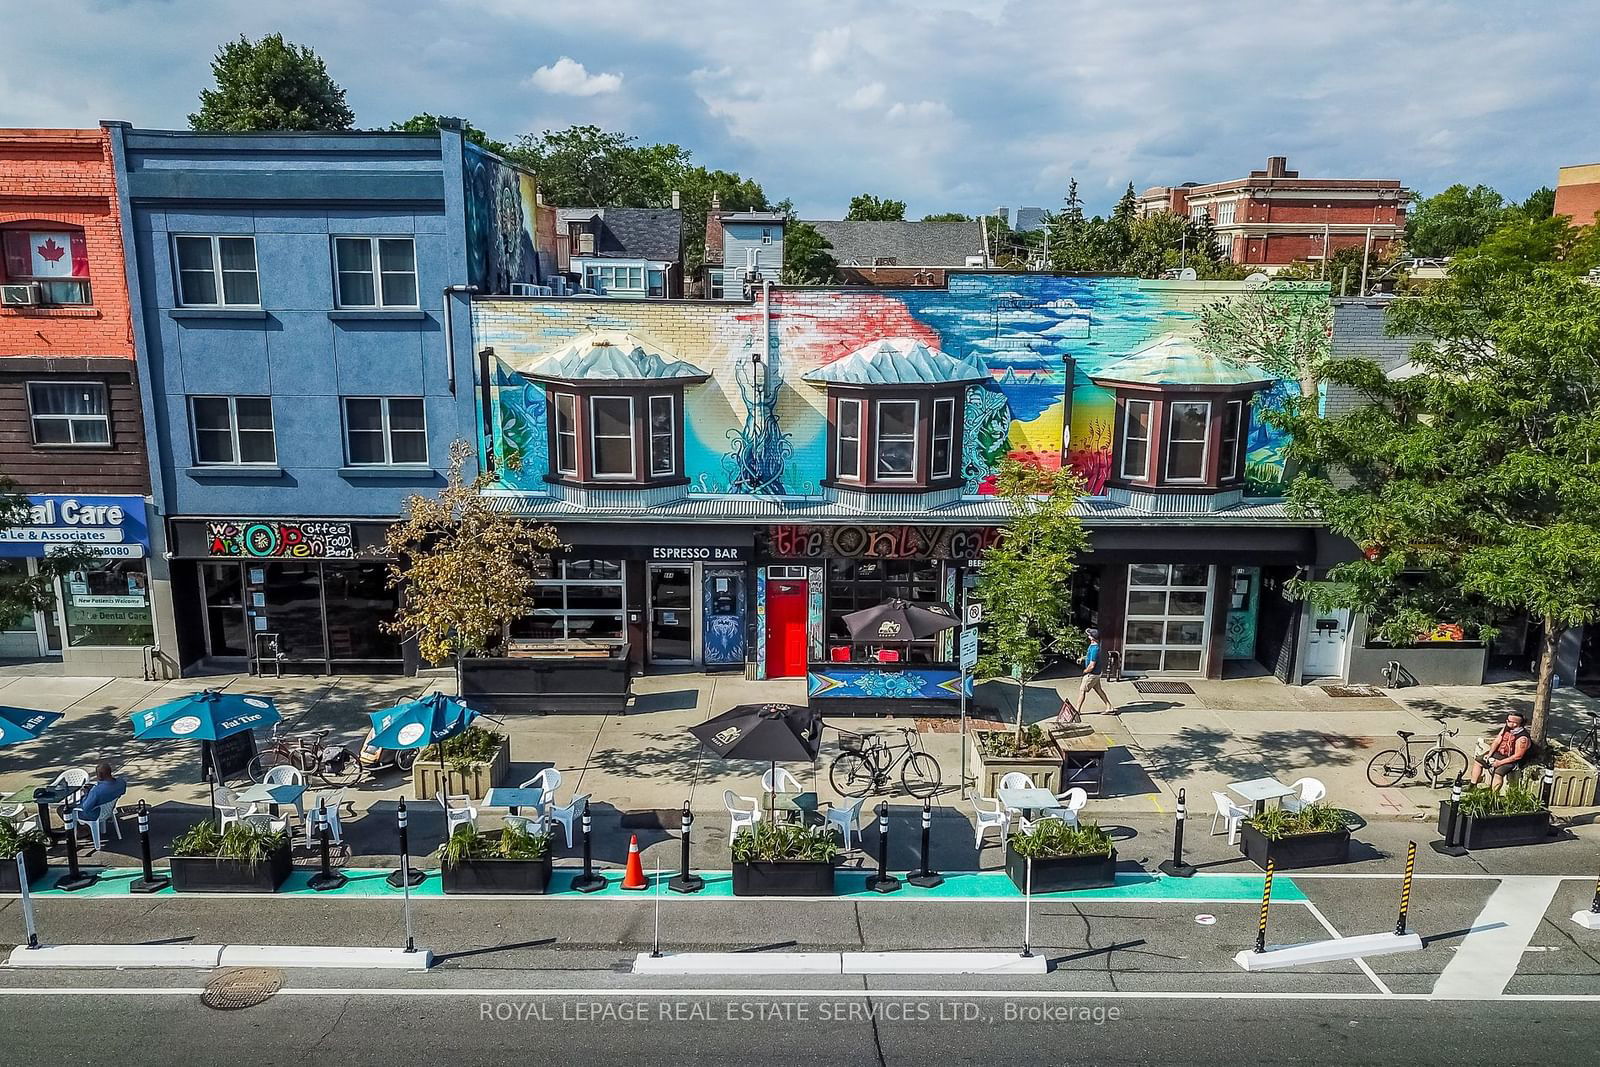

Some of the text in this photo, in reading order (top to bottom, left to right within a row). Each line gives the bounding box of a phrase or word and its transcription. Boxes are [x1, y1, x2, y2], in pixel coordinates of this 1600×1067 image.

[61, 499, 124, 526] Care
[10, 531, 24, 540] Le
[28, 531, 38, 540] &
[41, 530, 105, 541] Associates
[210, 523, 237, 536] We
[300, 523, 347, 537] Coffee
[211, 535, 240, 553] Are
[775, 525, 822, 556] the
[653, 547, 738, 559] ESPRESSO BAR
[99, 612, 126, 620] Dental
[128, 612, 147, 620] Care
[238, 713, 263, 723] Tire
